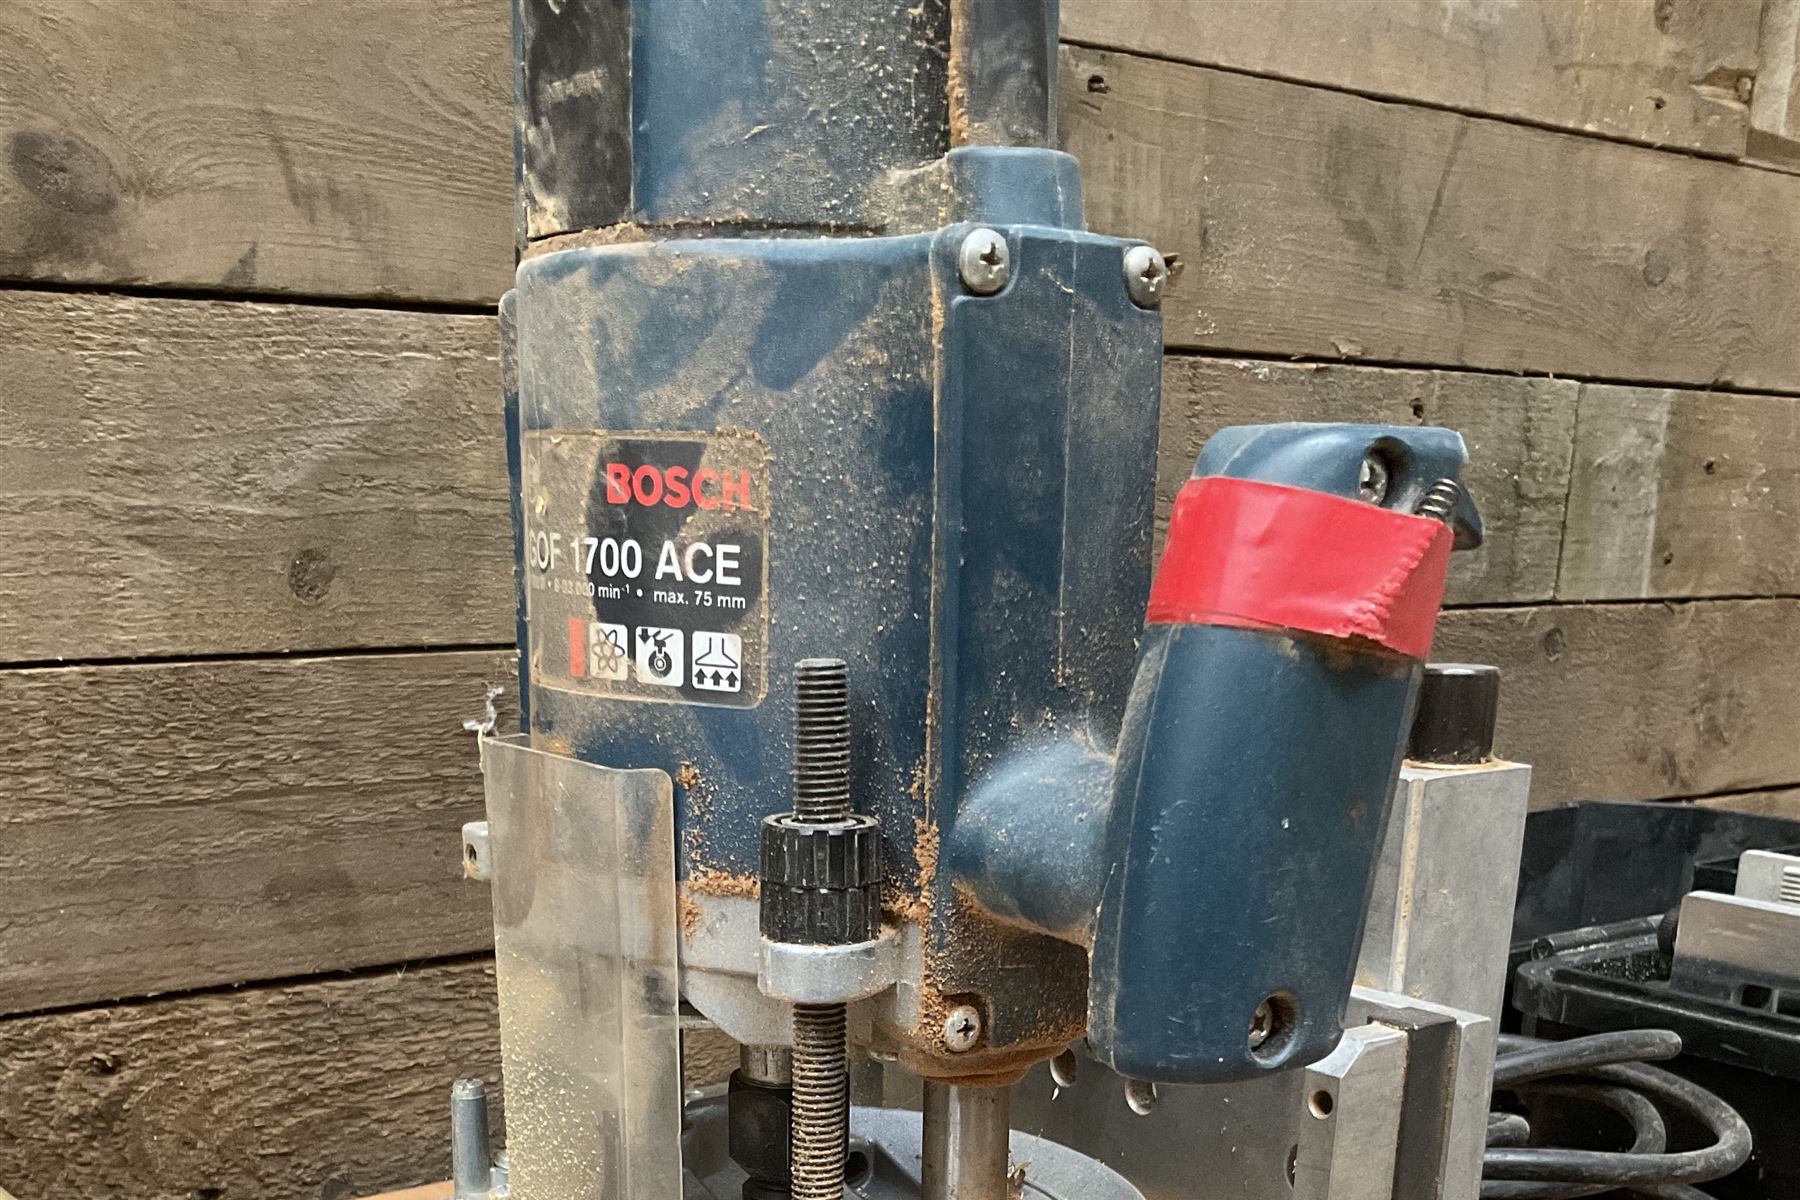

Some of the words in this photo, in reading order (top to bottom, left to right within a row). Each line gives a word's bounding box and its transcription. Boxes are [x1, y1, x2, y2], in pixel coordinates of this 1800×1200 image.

[606, 463, 751, 512] BOSCH
[529, 530, 562, 570] GOF
[570, 537, 643, 578] 1700
[655, 540, 742, 586] ACE
[654, 590, 690, 606] max.
[695, 592, 713, 607] 75
[717, 596, 747, 610] mm
